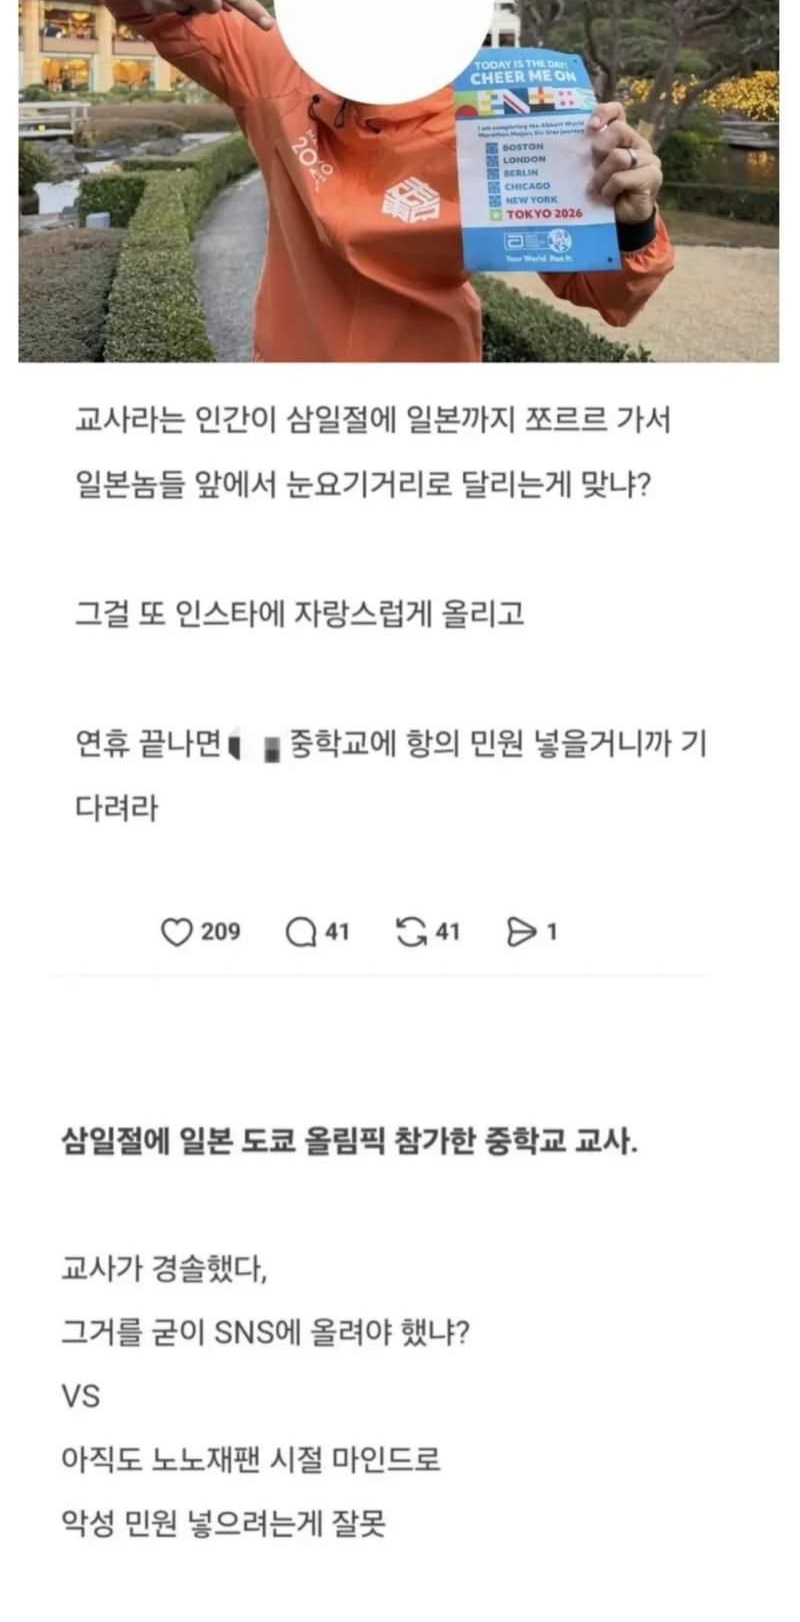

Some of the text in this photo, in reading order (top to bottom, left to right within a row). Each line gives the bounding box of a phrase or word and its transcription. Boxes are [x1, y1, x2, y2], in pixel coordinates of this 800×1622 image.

[475, 59, 512, 70] TODAY
[514, 59, 524, 69] IS
[526, 59, 548, 69] THE
[470, 69, 577, 85] CHEER ME ON
[502, 143, 544, 152] BOSTON
[503, 155, 546, 165] LONDON
[504, 169, 539, 178] BERLIN
[504, 182, 551, 191] CHICAGO
[505, 195, 558, 205] NEW YORK
[506, 208, 583, 220] TOKYO 2026
